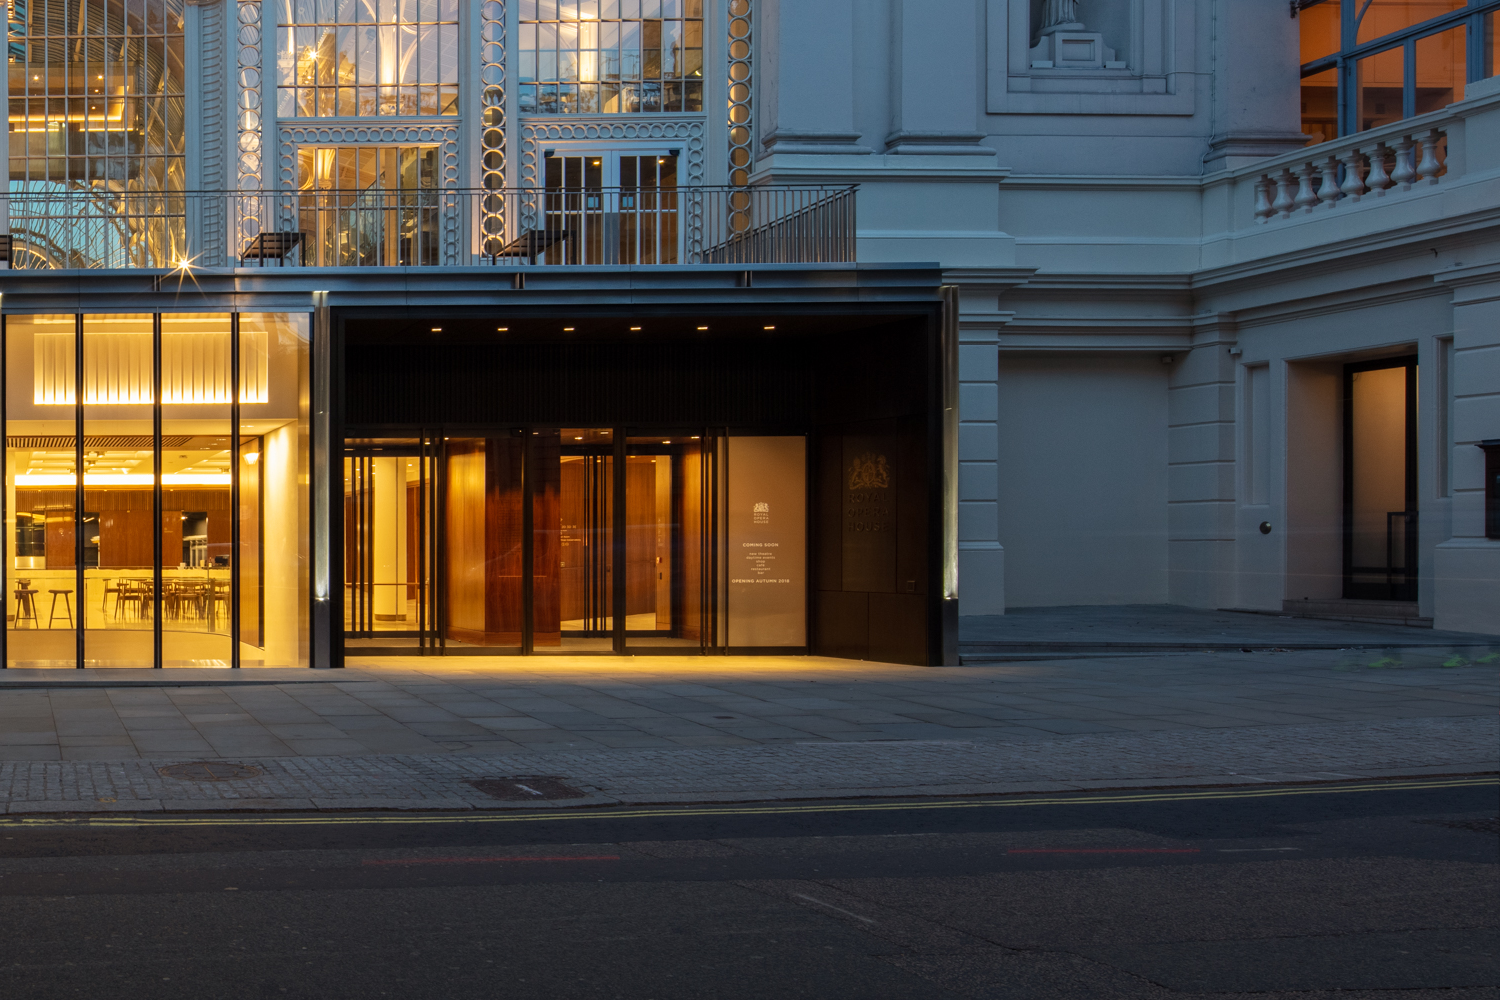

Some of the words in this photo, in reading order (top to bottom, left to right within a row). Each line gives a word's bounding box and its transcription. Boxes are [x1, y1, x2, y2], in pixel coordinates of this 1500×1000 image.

[849, 492, 888, 503] ROYAL
[848, 506, 889, 518] OPERA
[848, 521, 889, 532] HOUSE
